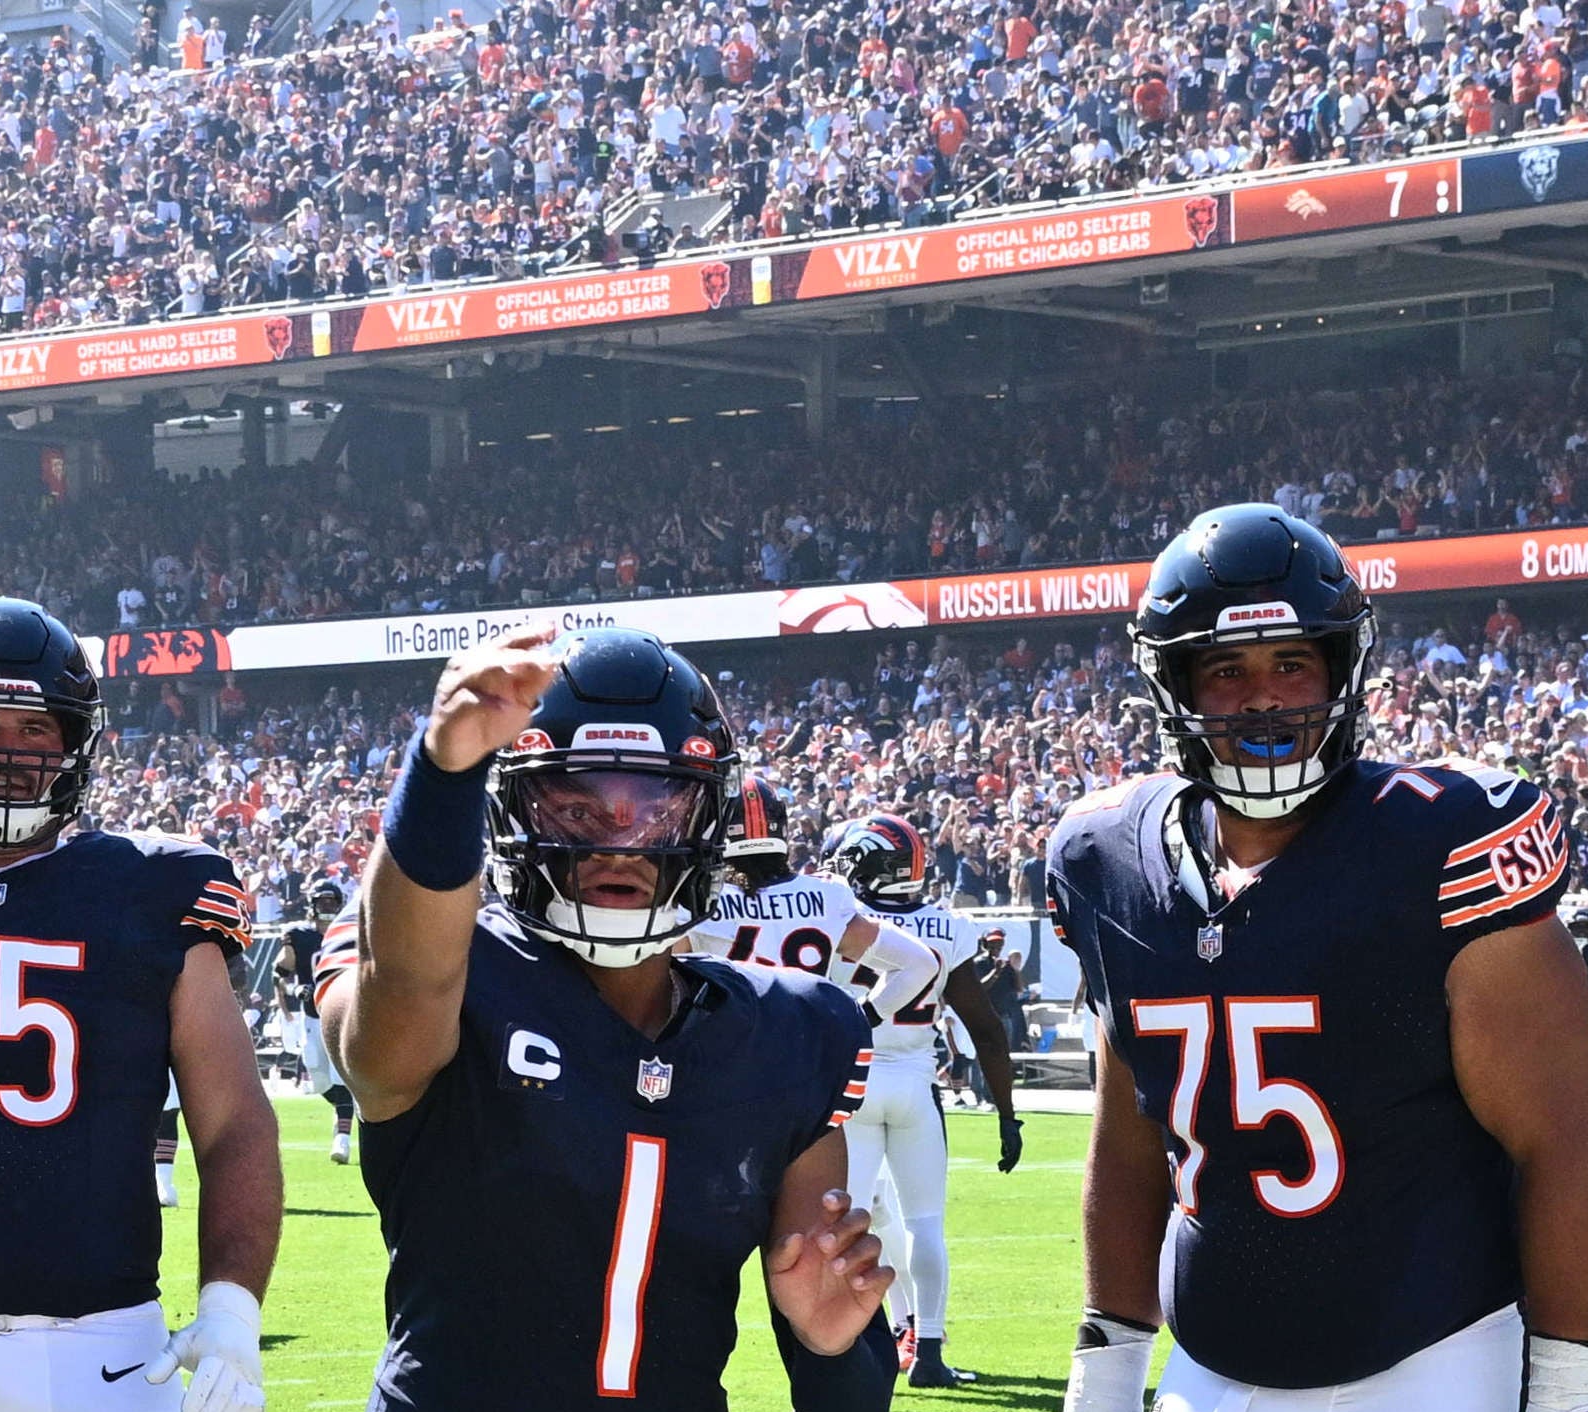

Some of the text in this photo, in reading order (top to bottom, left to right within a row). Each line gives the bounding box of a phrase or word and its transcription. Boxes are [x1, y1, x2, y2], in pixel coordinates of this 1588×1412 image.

[1385, 171, 1409, 217] 7
[956, 211, 1151, 254] OFFICIAL HARD SELTZER
[833, 238, 924, 277] VIZZY
[958, 232, 1151, 273] OF THE CHICAGO BEARS
[495, 275, 670, 311] OFFICIAL HARD SELTZER
[844, 272, 916, 290] HARD SELTZER
[386, 296, 465, 331] VIZZY
[497, 294, 670, 329] OF THE CHICAGO BEARS
[78, 328, 237, 359] OFFICIAL HARD SELTZER
[79, 344, 237, 376] OF THE CHICAGO BEARS
[1357, 558, 1397, 592] YDS
[1521, 540, 1540, 579] 8
[939, 571, 1129, 619] RUSSELL WILSON
[1229, 608, 1286, 622] BEARS
[385, 624, 470, 655] In-Game
[585, 730, 650, 742] BEARS
[1490, 818, 1557, 895] GSH
[711, 891, 825, 922] SINGLETON
[1202, 940, 1220, 953] NFL
[506, 1028, 562, 1082] C
[643, 1076, 665, 1093] NFL
[1130, 995, 1346, 1219] 75
[596, 1131, 667, 1399] 1
